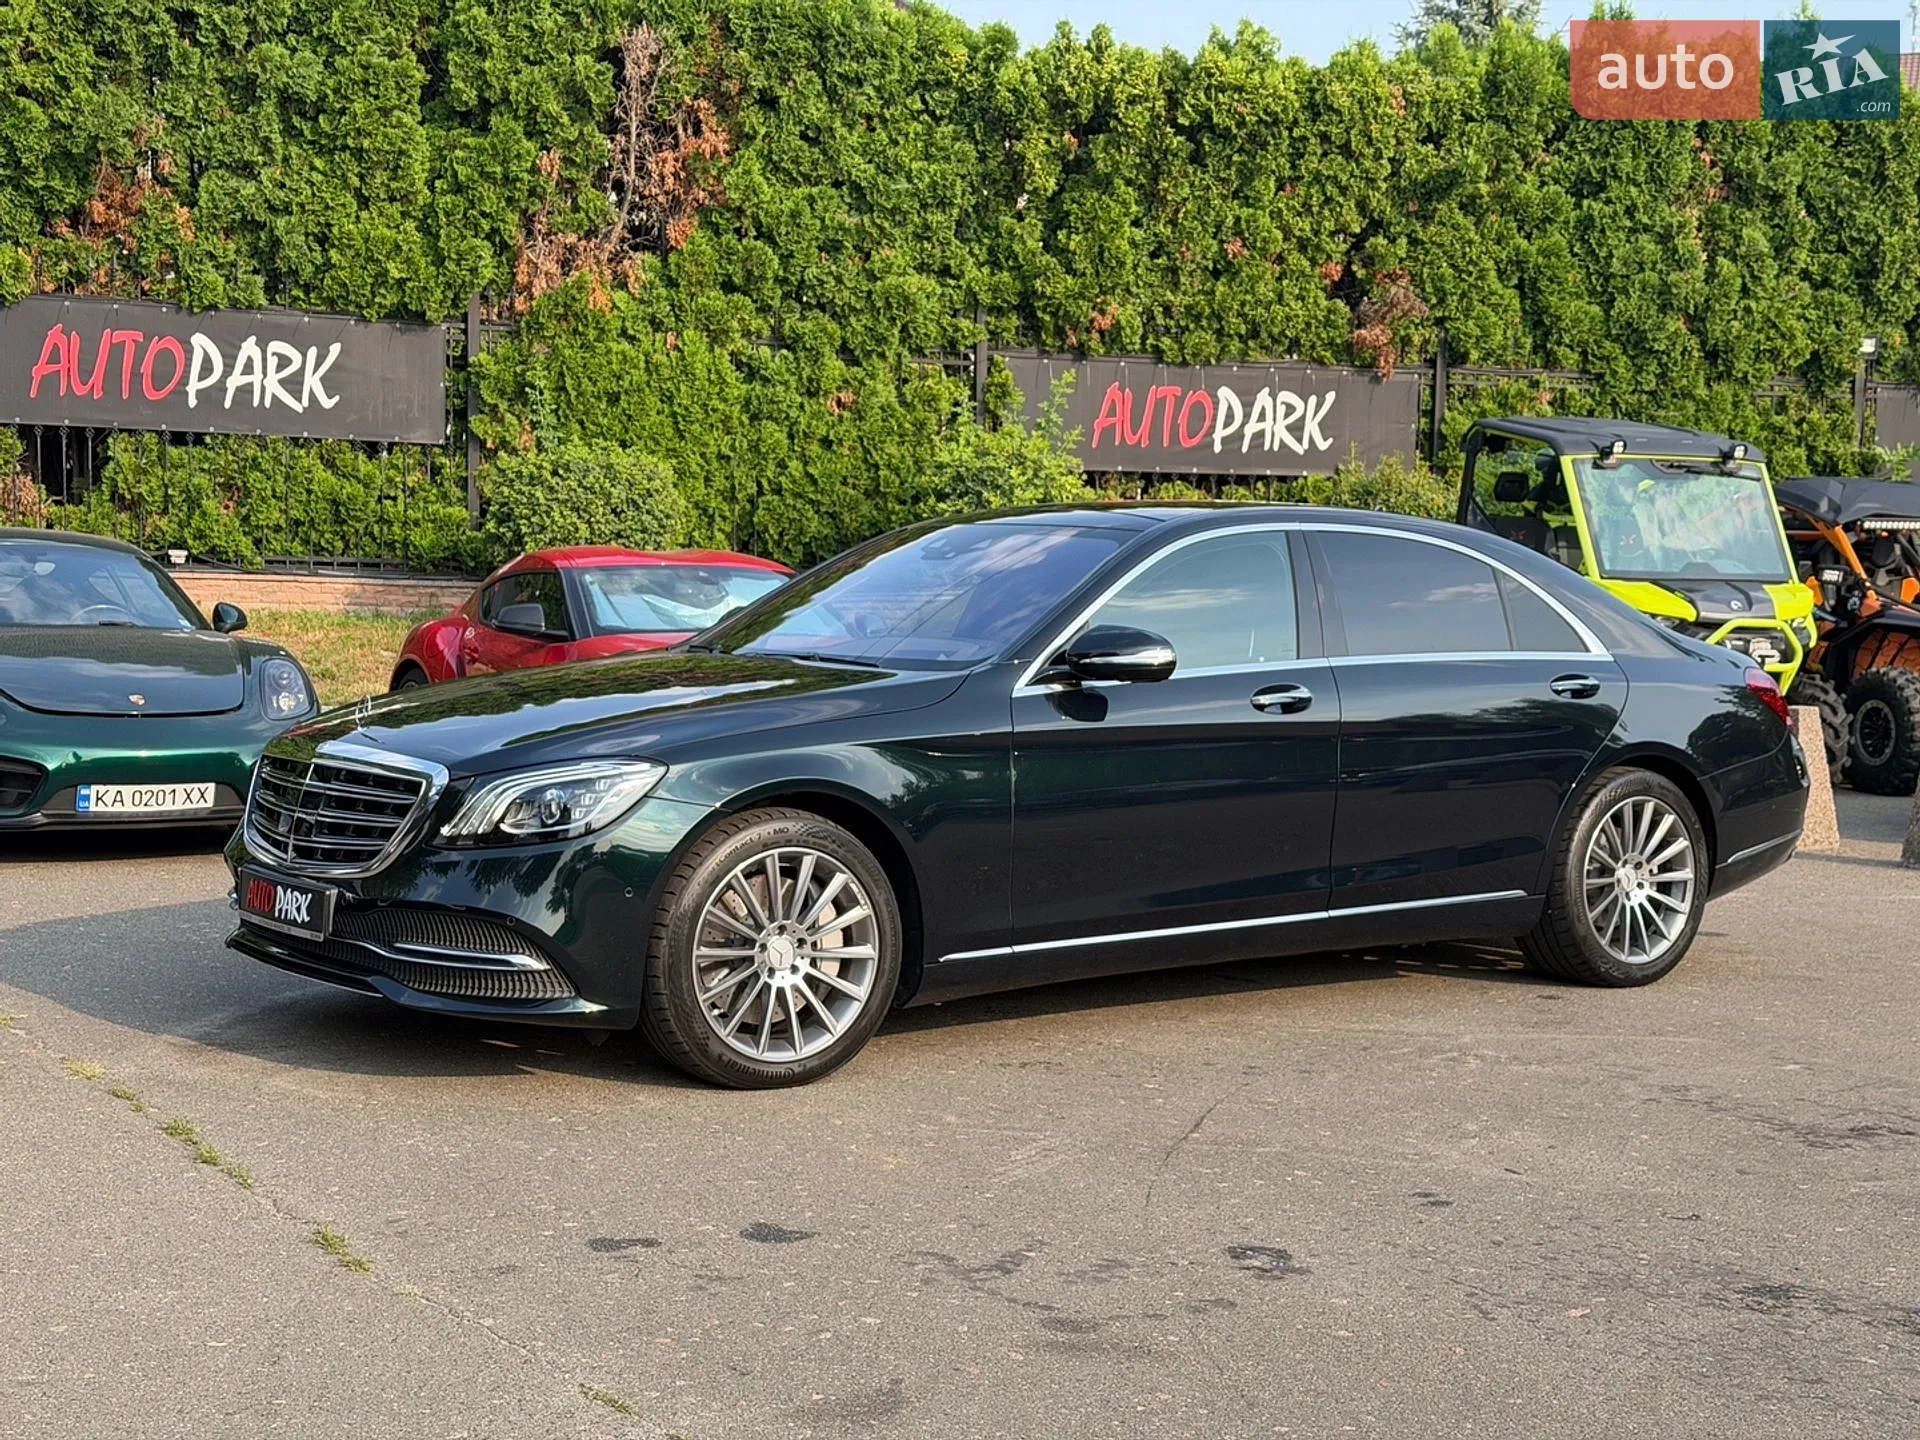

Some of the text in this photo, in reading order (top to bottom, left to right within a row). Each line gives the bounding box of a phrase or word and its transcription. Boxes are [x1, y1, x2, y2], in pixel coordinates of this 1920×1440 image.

[30, 323, 342, 414] AUTOPARK
[1092, 381, 1336, 456] AUTOPARK
[95, 786, 209, 808] KA 0201 XX
